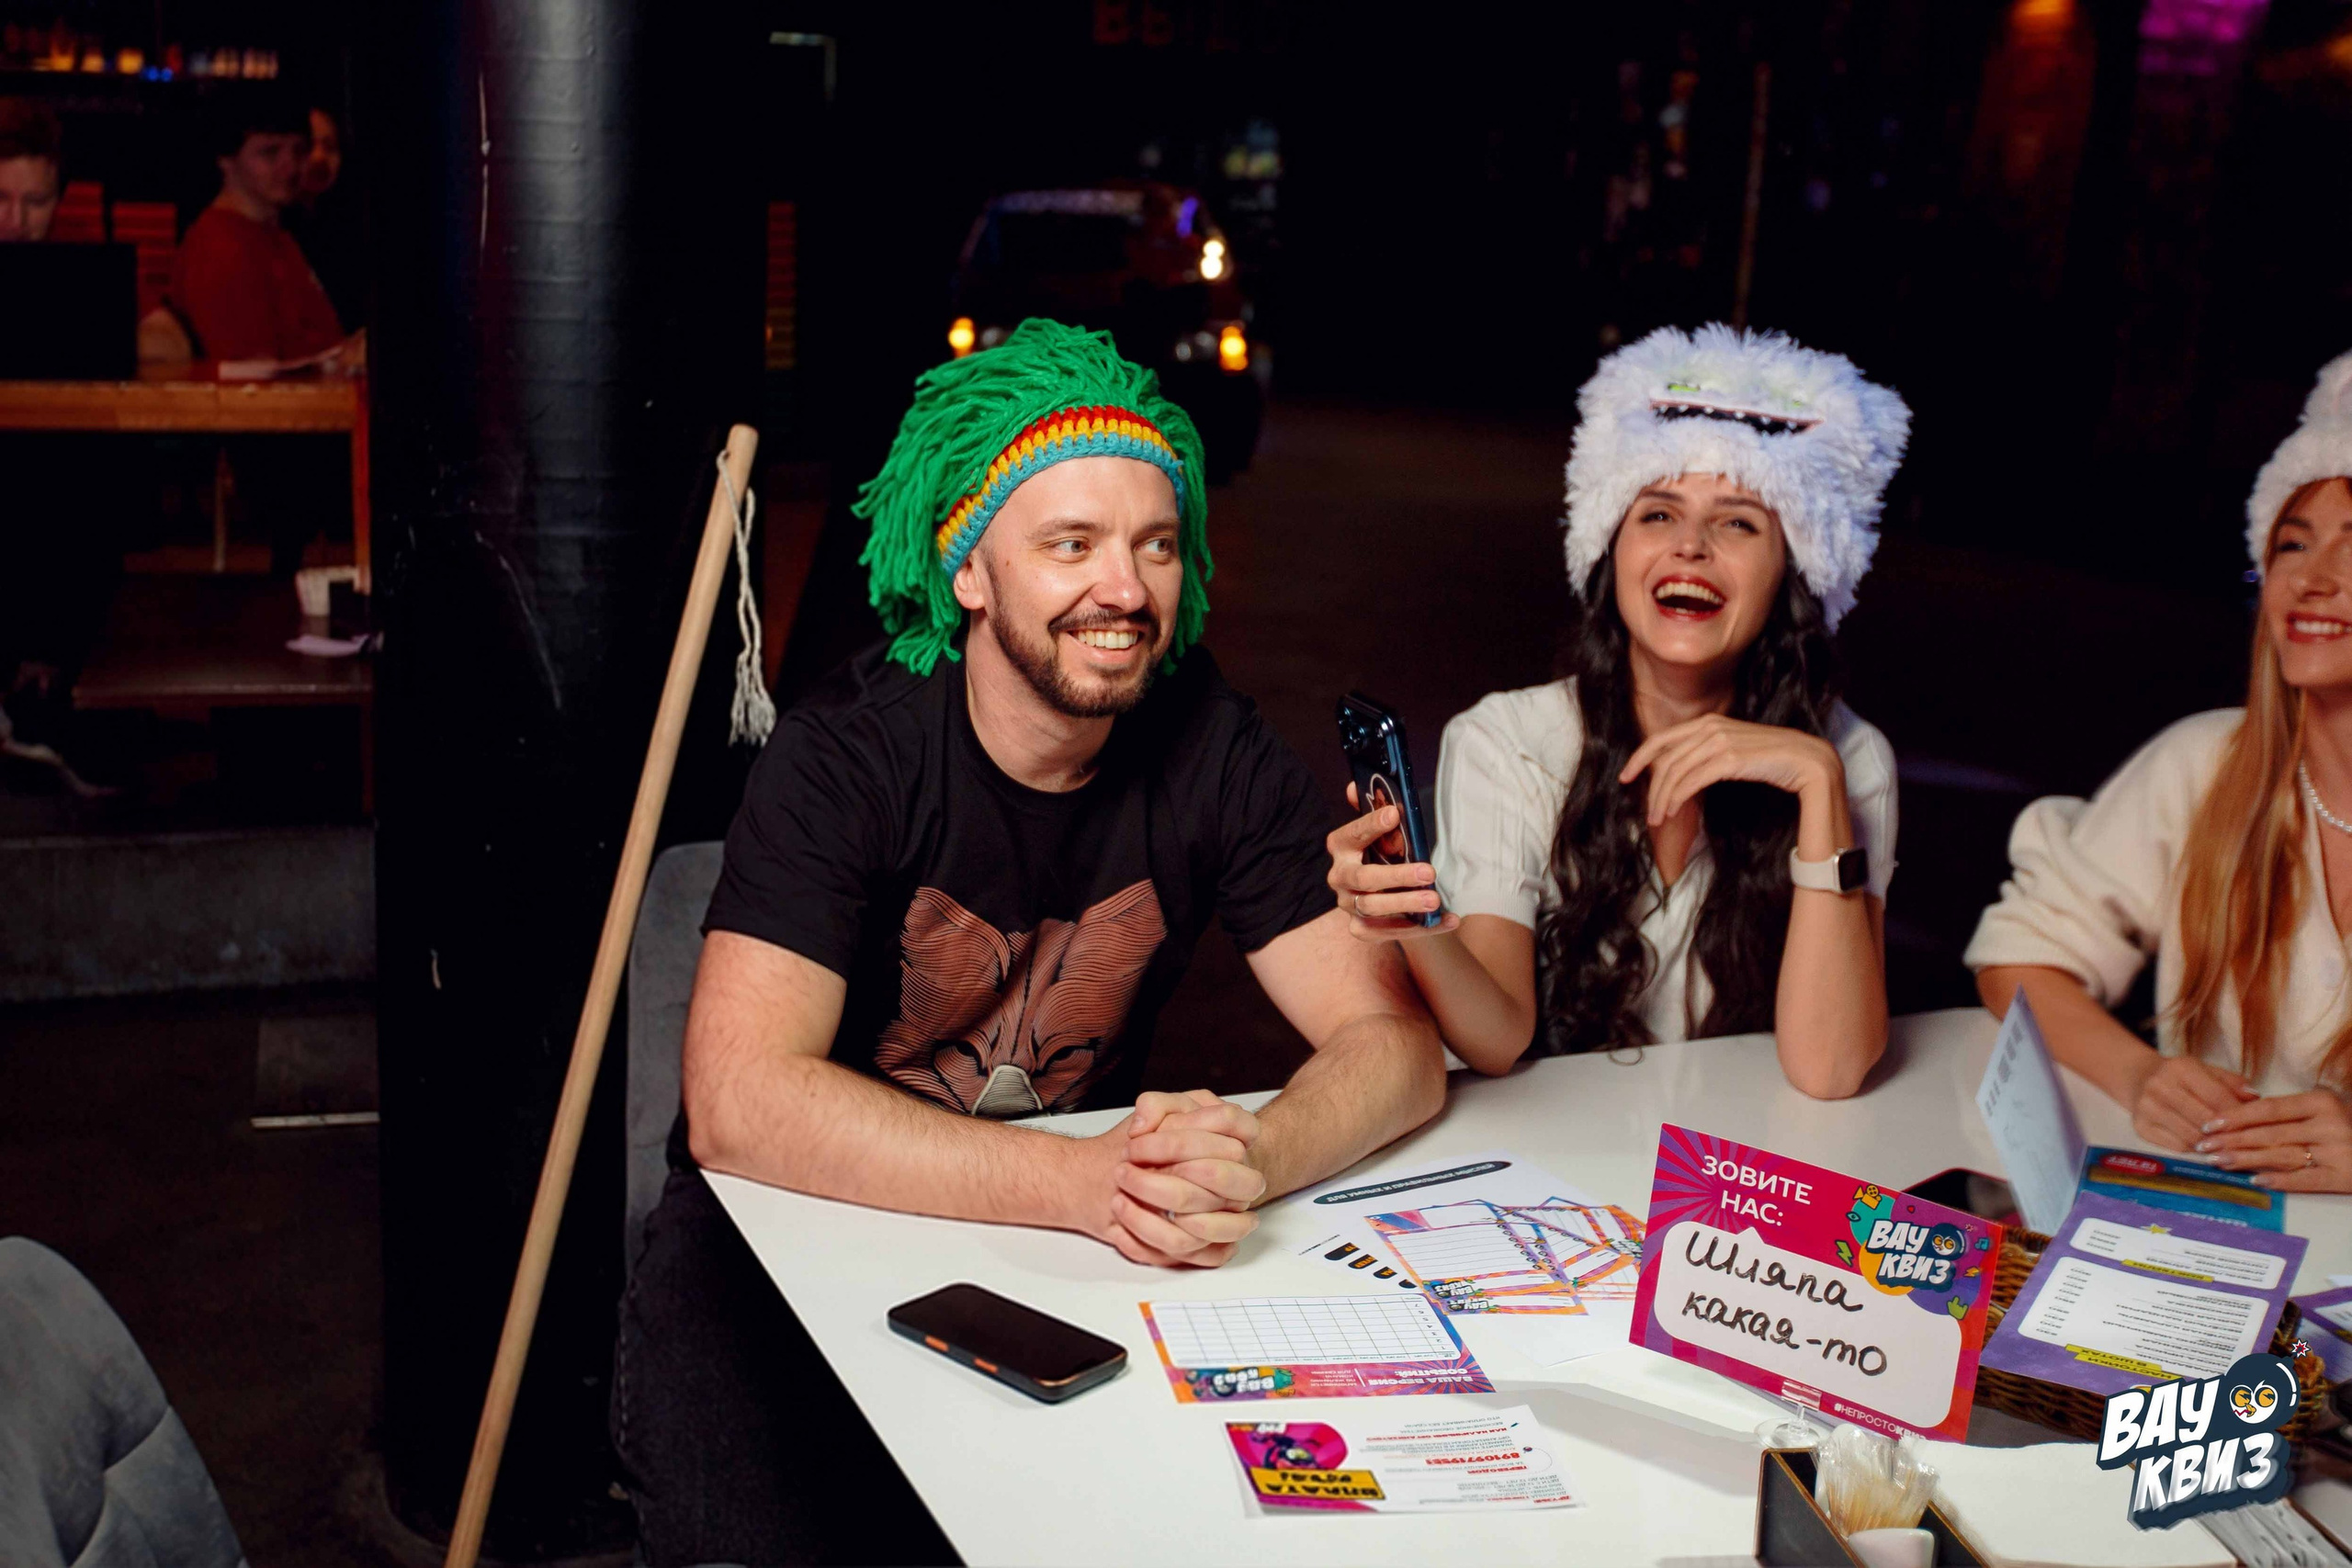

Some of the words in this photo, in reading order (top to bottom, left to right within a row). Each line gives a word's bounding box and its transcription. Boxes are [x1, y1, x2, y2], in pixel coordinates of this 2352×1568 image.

[1701, 1155, 1813, 1205] ЗОВИТЕ
[1721, 1191, 1784, 1227] НАС:
[1867, 1219, 1929, 1255] ВАУ
[1685, 1230, 1864, 1314] Шляпа
[1877, 1251, 1951, 1284] КВИЗ
[1681, 1291, 1888, 1376] какая-то
[1367, 1378, 1425, 1386] ВЕРСИЯ
[1394, 1368, 1468, 1379] СОБЫТИЙ:
[1425, 1376, 1474, 1384] ВАША
[2087, 1357, 2172, 1380] НАСТОЙКИ
